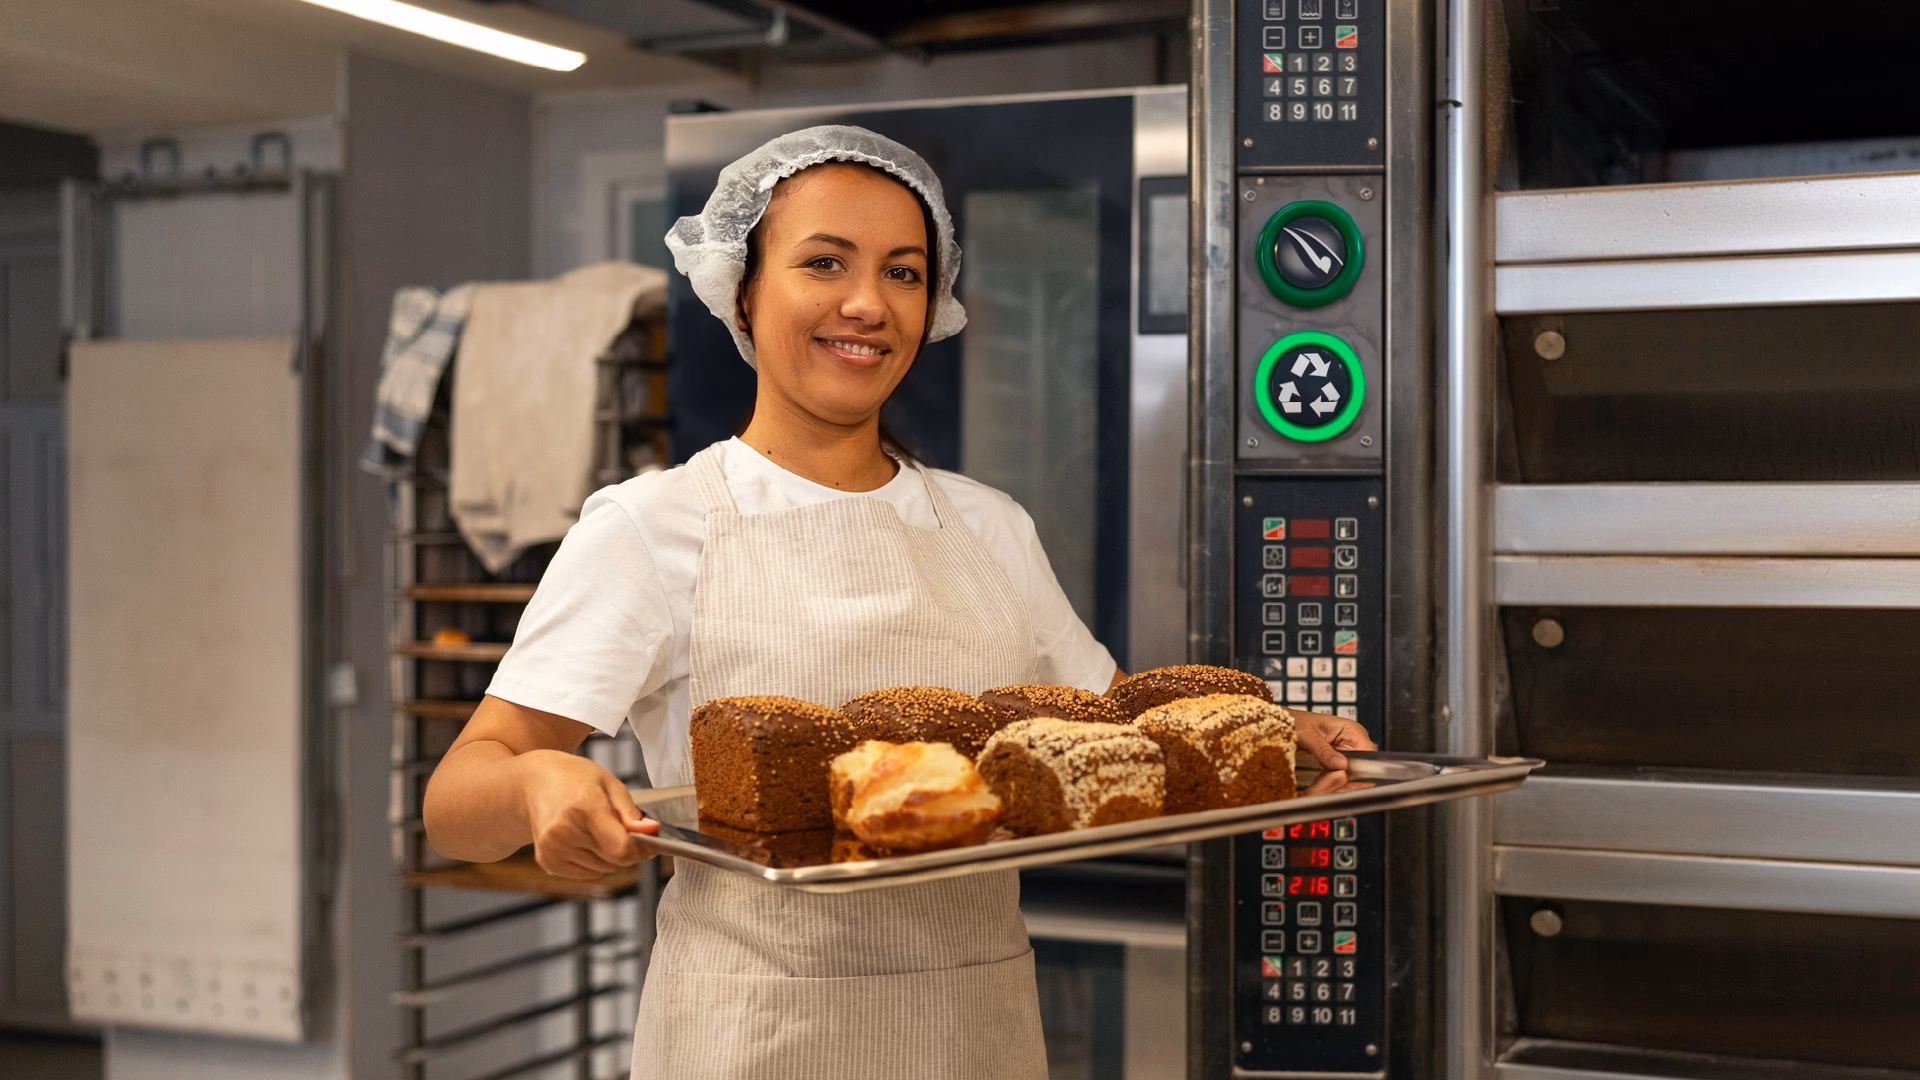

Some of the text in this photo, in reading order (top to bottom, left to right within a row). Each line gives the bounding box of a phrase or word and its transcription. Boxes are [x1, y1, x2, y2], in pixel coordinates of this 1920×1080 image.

[1294, 56, 1355, 72] 1 2 3
[1269, 78, 1355, 95] 4 5 6 7
[1269, 103, 1356, 120] 8 9 10 11
[1310, 849, 1329, 867] 19
[1289, 876, 1329, 895] 216
[1293, 960, 1354, 978] 1 2 3
[1268, 983, 1354, 1000] 4 5 6 7
[1268, 1006, 1356, 1025] 8 9 10 11
